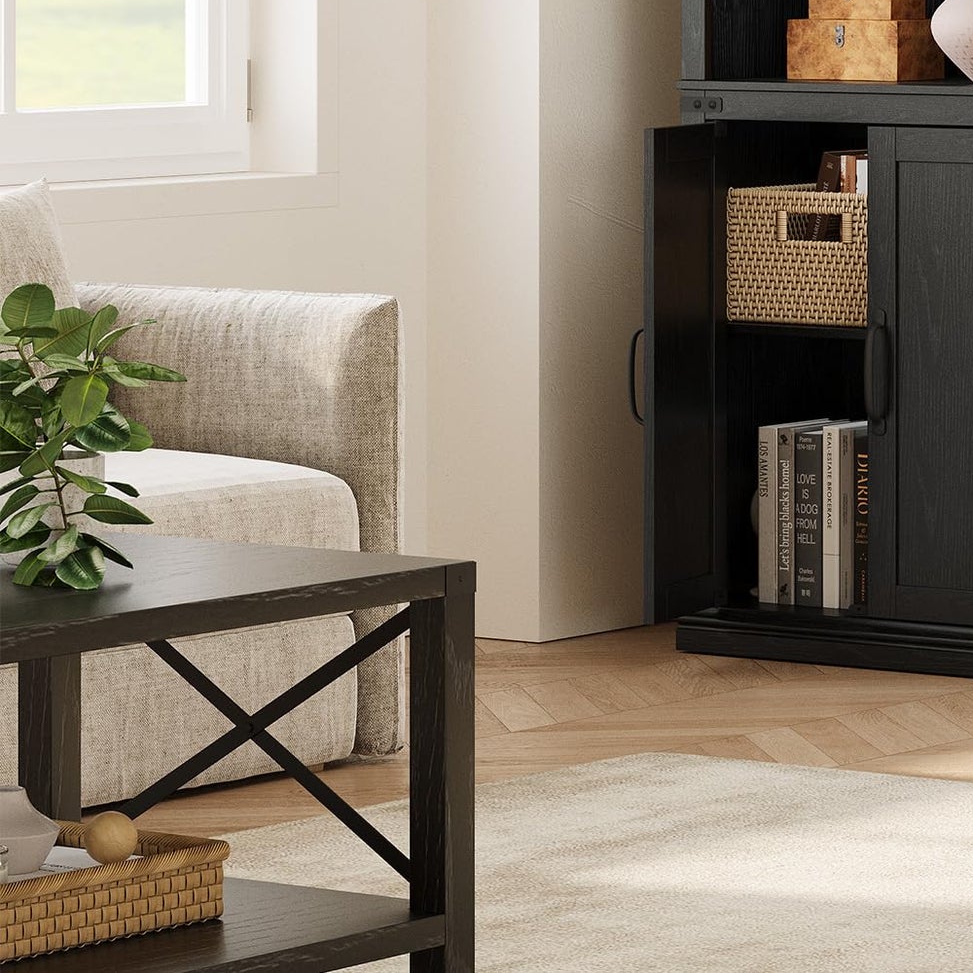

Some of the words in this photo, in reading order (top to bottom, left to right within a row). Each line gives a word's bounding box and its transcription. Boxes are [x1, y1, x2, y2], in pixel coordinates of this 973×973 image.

[759, 440, 769, 457] LOS
[759, 457, 769, 498] AMANTES
[779, 459, 790, 490] home!
[796, 473, 817, 485] LOVE
[857, 453, 868, 515] DIARIO
[802, 488, 810, 500] IS
[779, 490, 790, 521] blacks
[800, 503, 818, 515] DOG
[779, 521, 792, 547] bring
[796, 517, 817, 530] FROM
[797, 532, 816, 545] HELL
[779, 547, 790, 572] Let's
